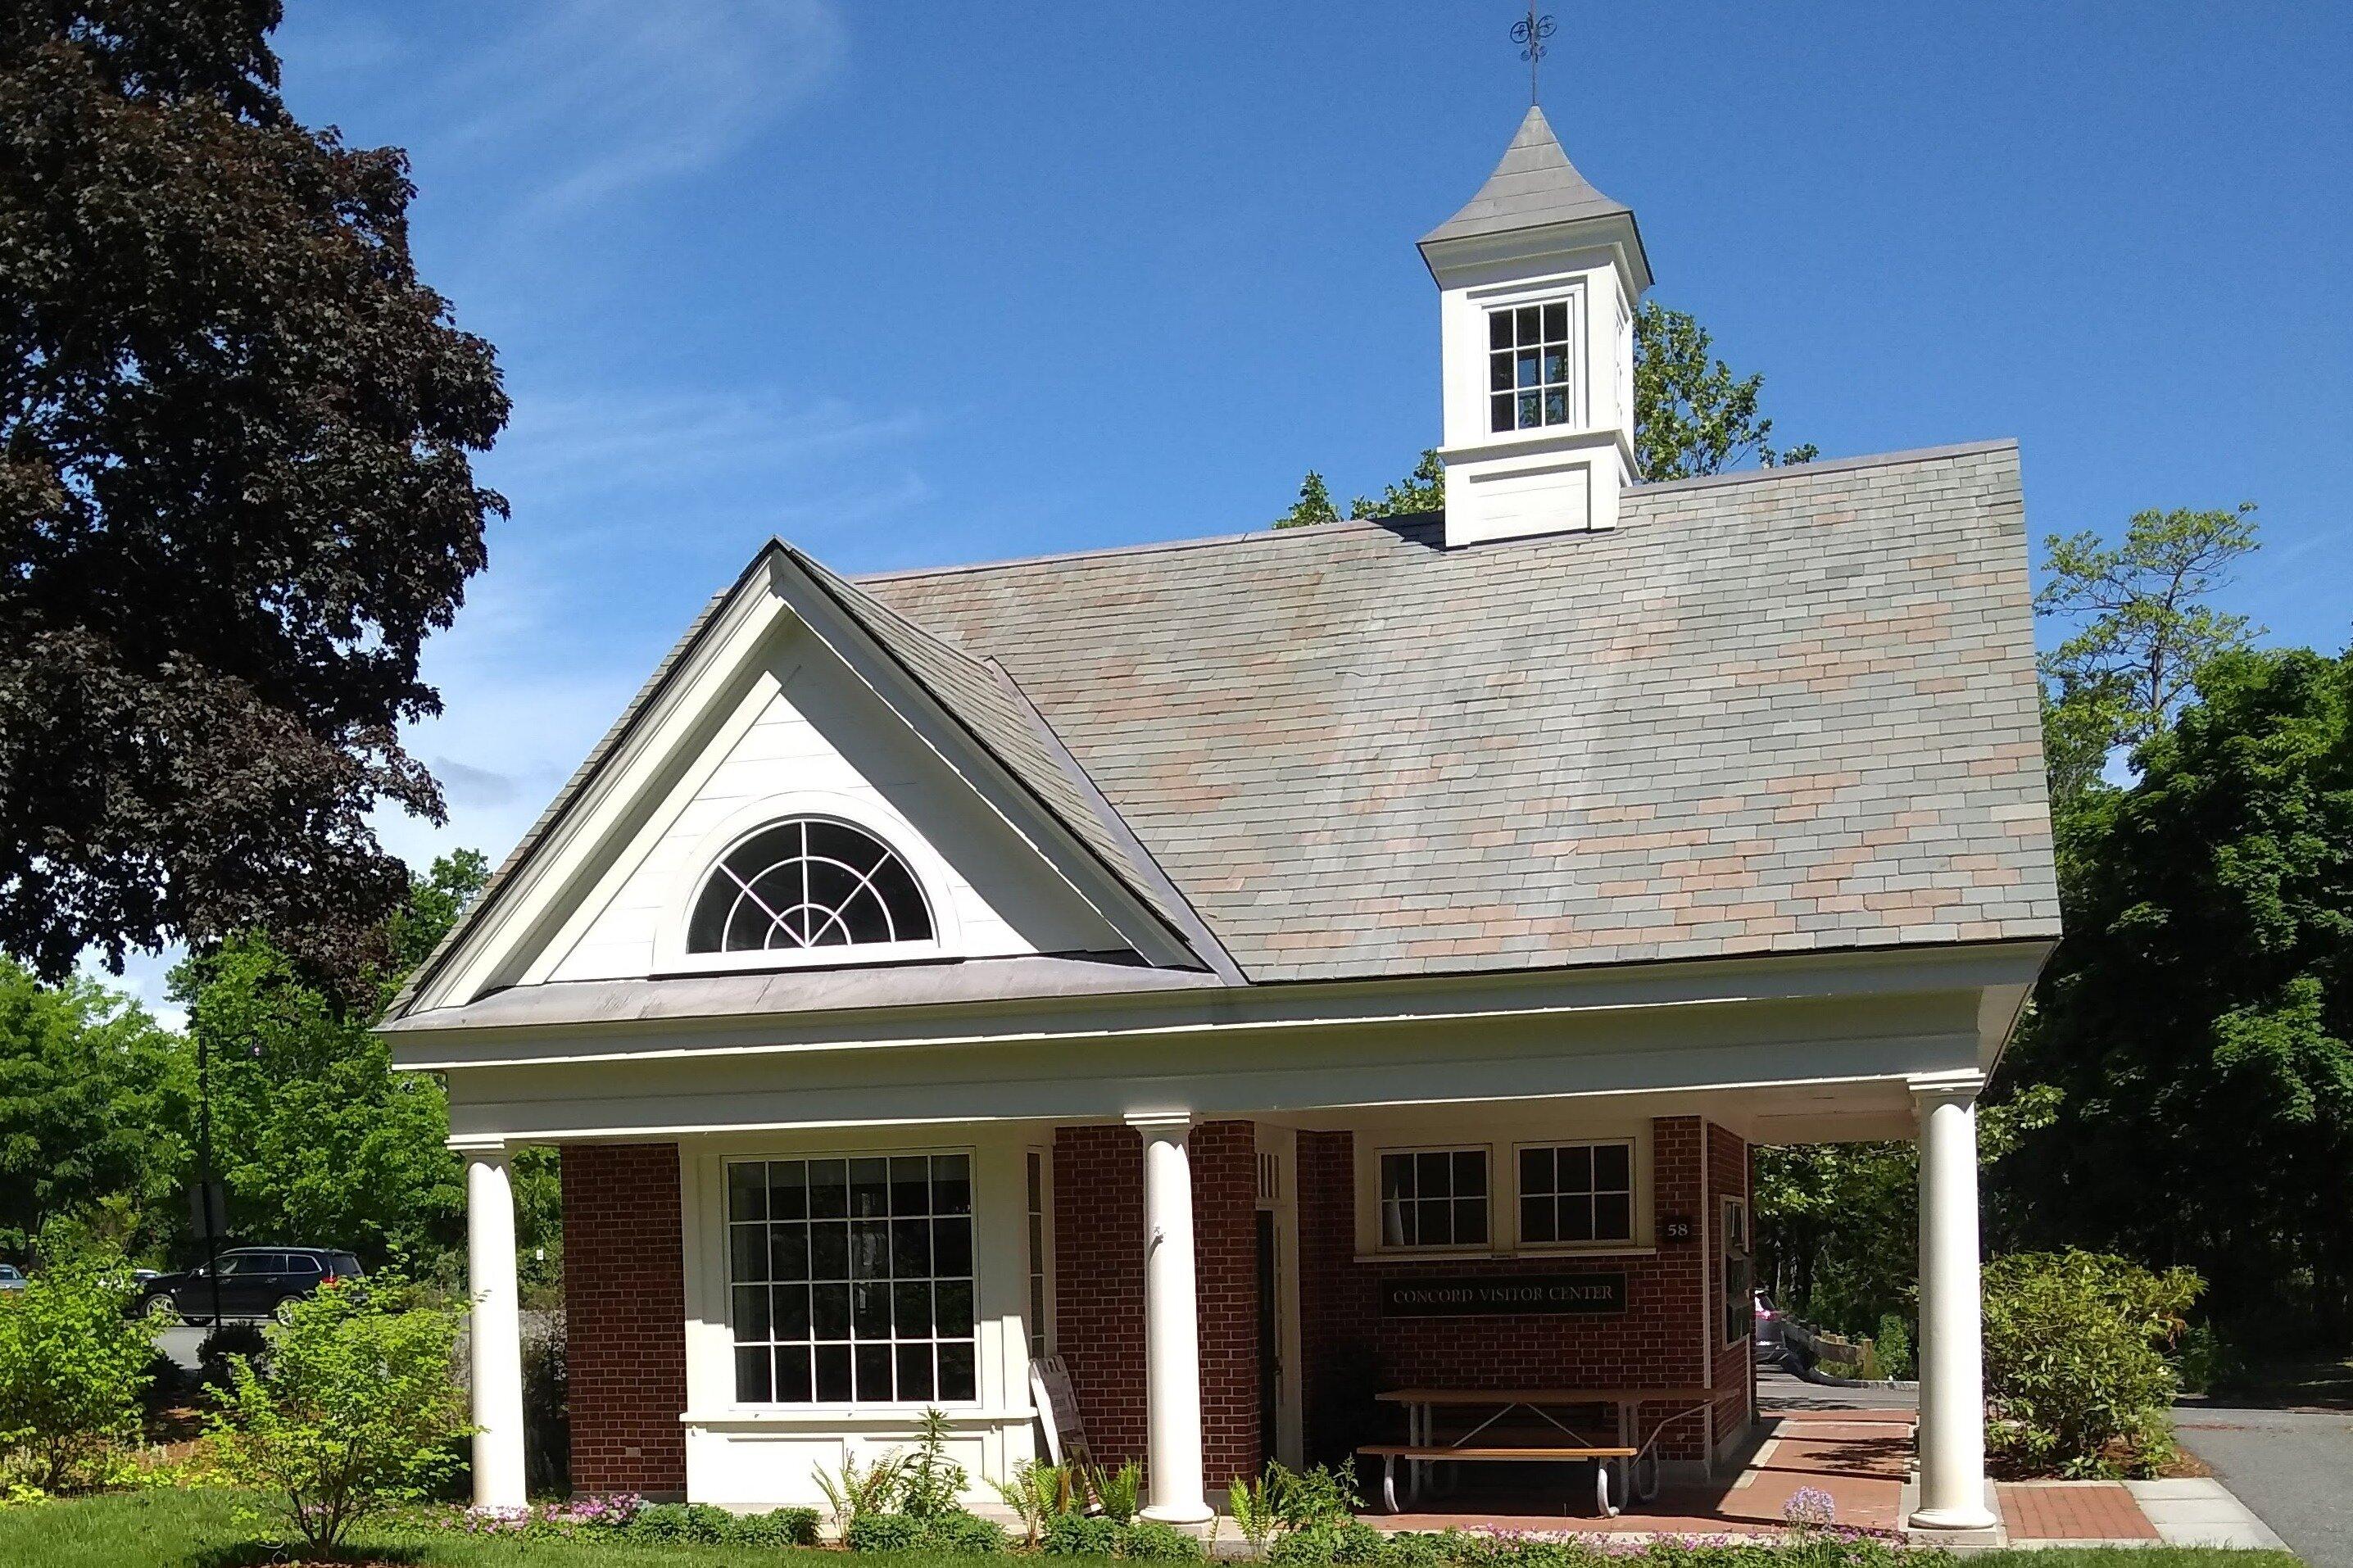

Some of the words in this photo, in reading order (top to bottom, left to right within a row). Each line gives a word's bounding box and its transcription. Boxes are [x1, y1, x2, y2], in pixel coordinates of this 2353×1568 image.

[1667, 1223, 1689, 1236] 58
[1393, 1289, 1474, 1303] CONCORD
[1479, 1287, 1543, 1301] VISITOR
[1548, 1285, 1614, 1300] CENTER
